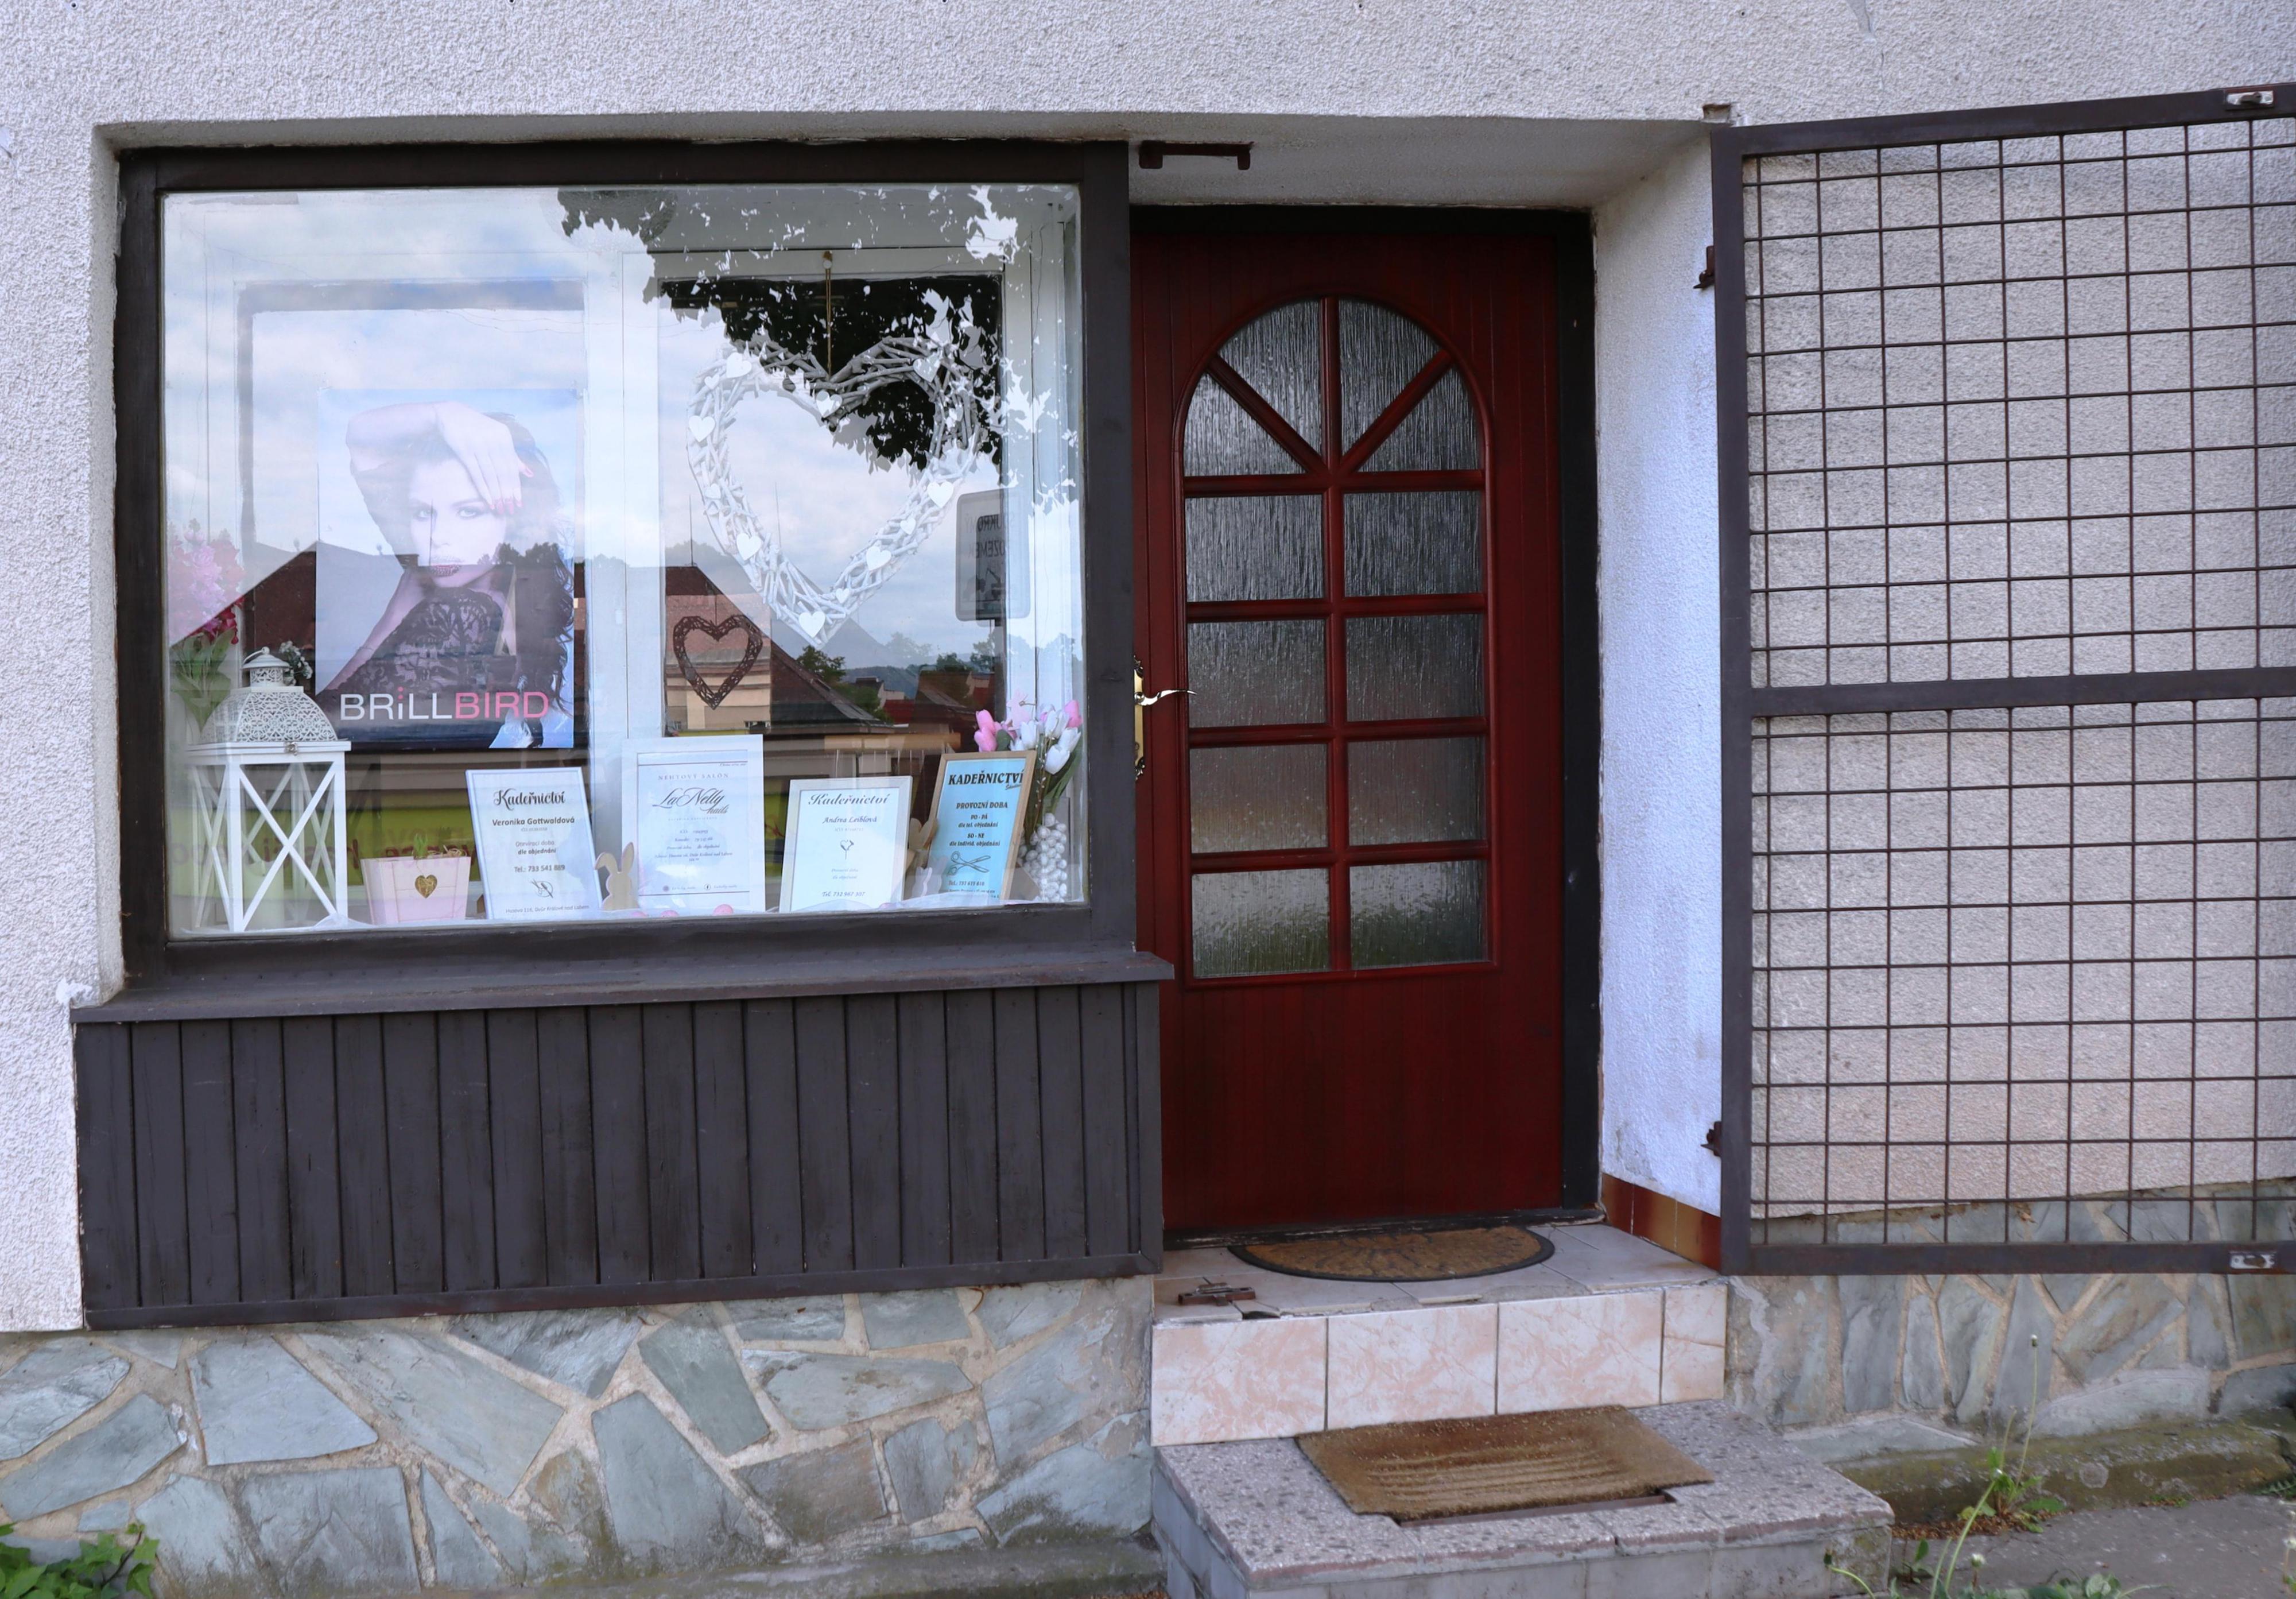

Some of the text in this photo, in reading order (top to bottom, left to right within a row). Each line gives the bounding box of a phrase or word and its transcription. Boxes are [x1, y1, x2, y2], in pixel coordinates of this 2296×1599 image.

[948, 769, 1025, 785] KADEŘNICTVÍ
[494, 788, 565, 811] Kadeřnictví
[808, 793, 890, 806] Kadeřnictví
[956, 800, 988, 809] PROVOZNÍ
[492, 816, 575, 826] Veronika Gottwaldová
[822, 816, 847, 824] Andrea
[528, 847, 556, 855] objednání
